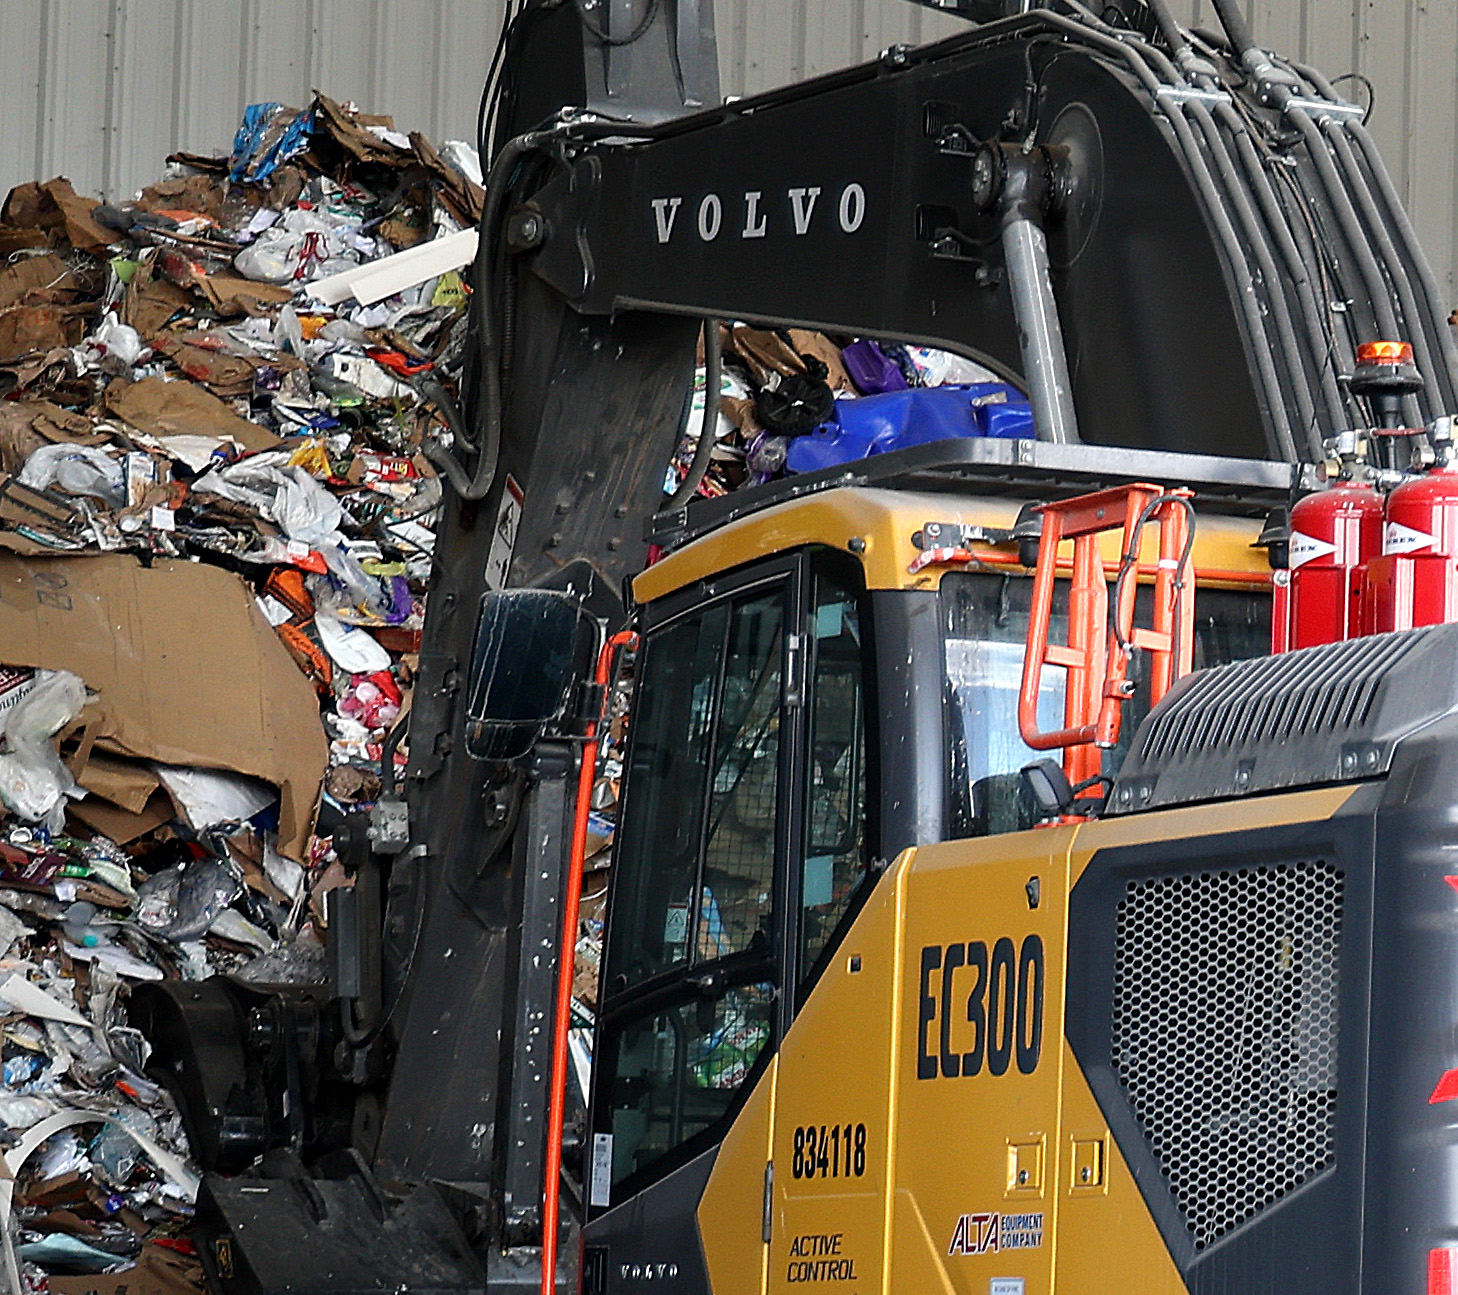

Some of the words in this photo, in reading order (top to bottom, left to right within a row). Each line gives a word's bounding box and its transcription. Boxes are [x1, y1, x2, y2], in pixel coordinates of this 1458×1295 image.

[651, 183, 865, 243] VOLVO
[917, 934, 1044, 1080] EC300
[792, 1123, 866, 1180] 834118
[790, 1234, 843, 1257] ACTIVE
[948, 1212, 1000, 1255] ALTA
[1001, 1213, 1044, 1232] EQUIPMENT
[1001, 1231, 1044, 1250] COMPANY
[787, 1259, 858, 1283] CONTROL
